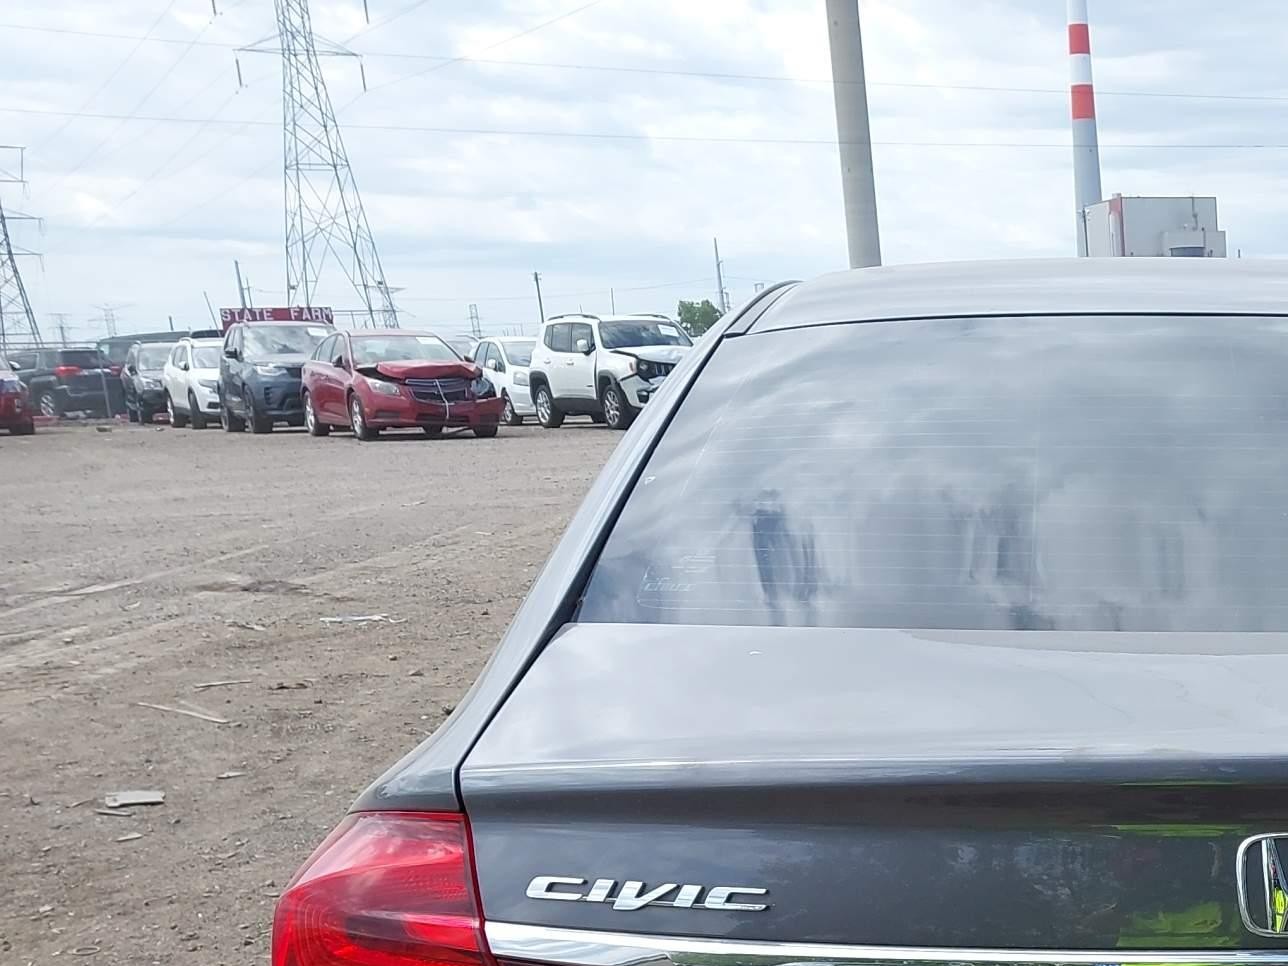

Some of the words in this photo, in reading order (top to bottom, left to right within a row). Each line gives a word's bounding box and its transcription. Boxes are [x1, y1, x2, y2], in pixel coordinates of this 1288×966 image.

[221, 308, 274, 321] STATE
[290, 307, 333, 322] FARM
[526, 875, 769, 911] CIVIC
